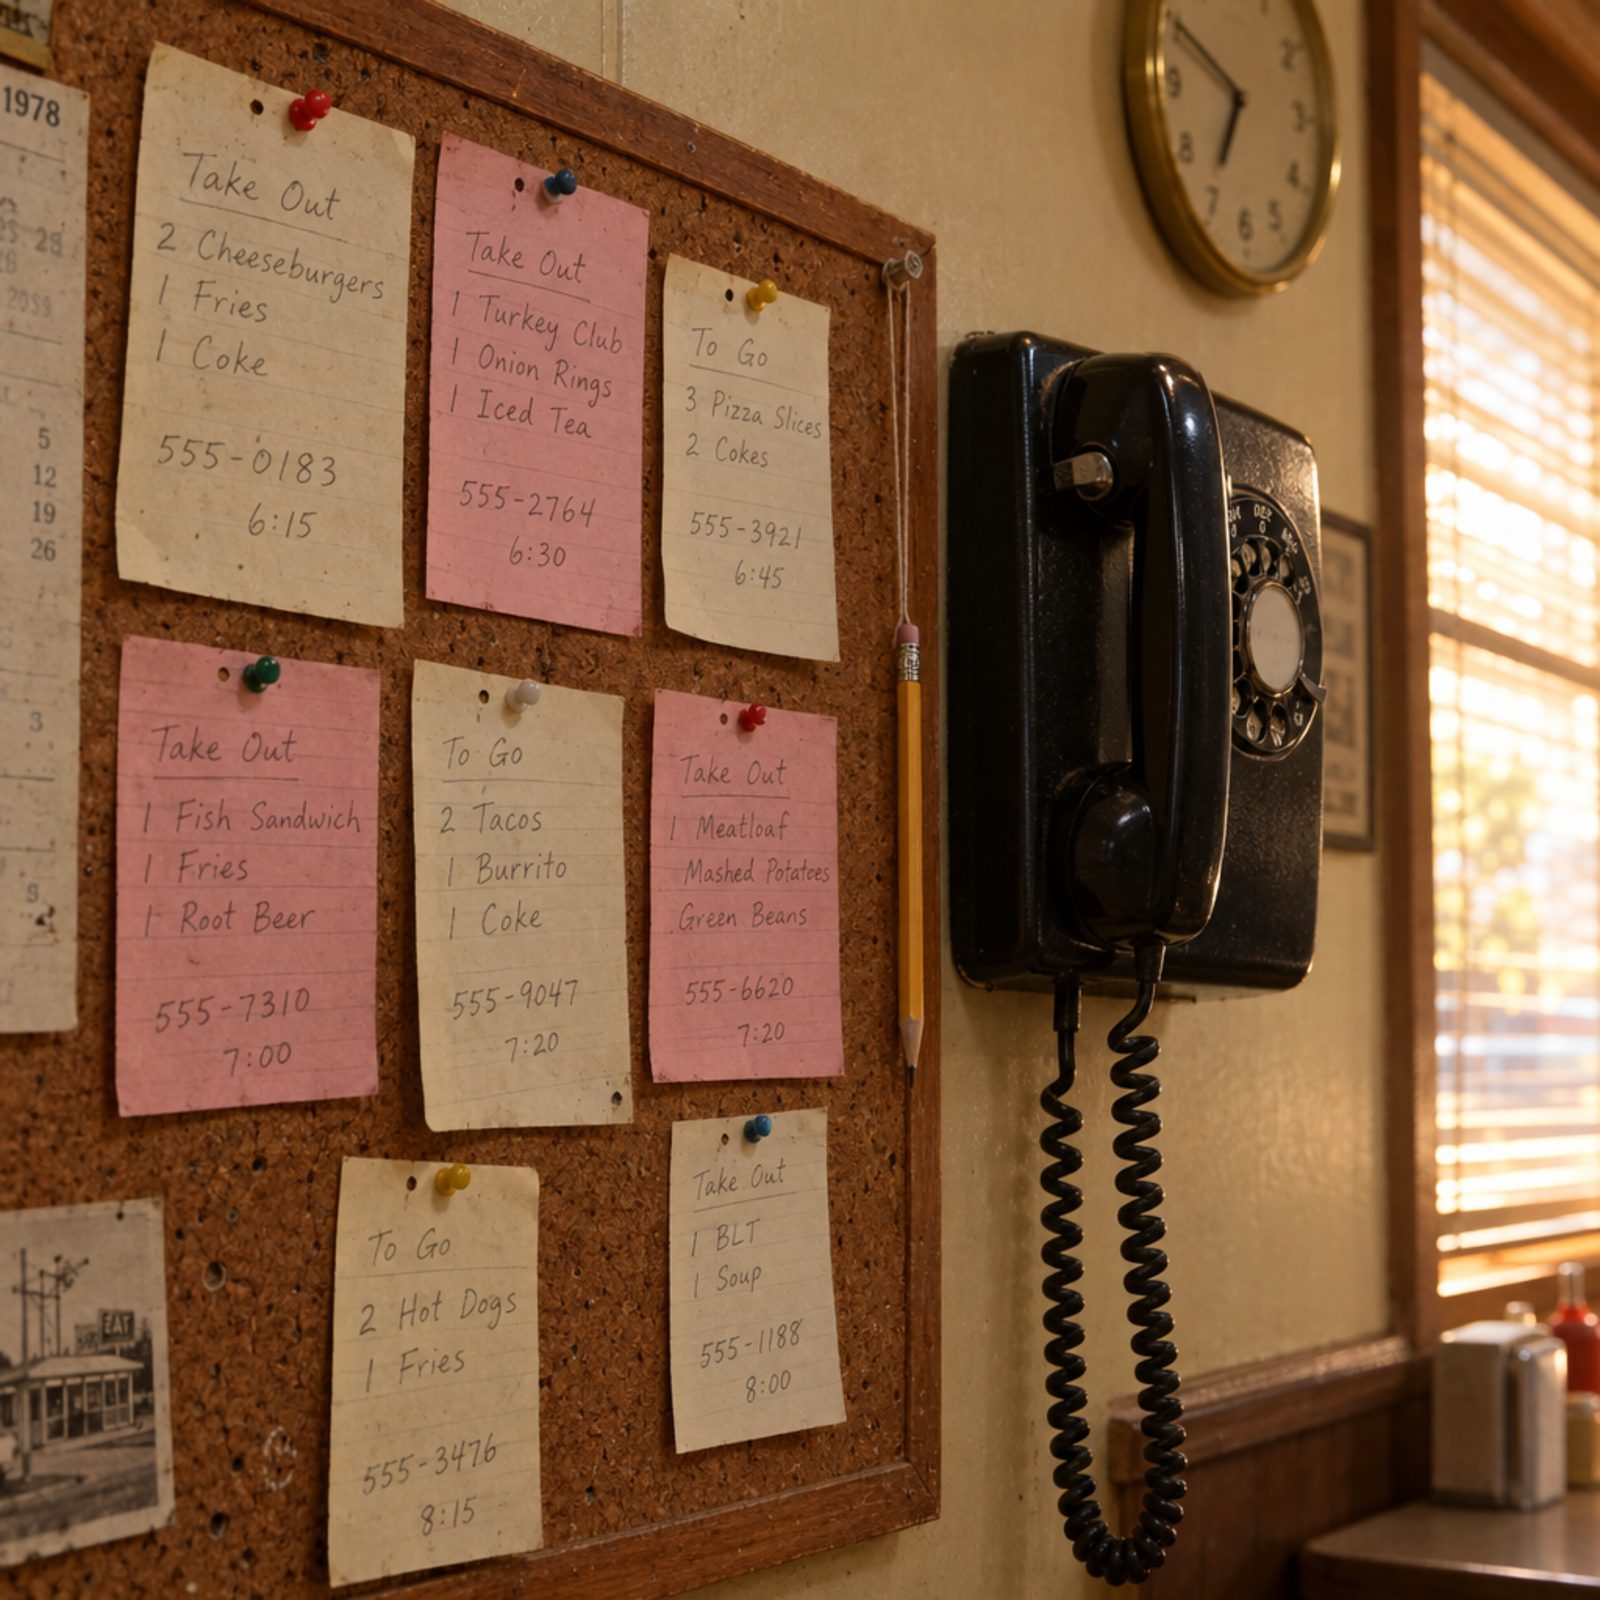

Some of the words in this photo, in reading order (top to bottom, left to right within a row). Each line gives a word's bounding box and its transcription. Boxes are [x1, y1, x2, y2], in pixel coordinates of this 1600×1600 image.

[3, 86, 60, 127] 1978
[183, 153, 258, 200] Take
[281, 180, 340, 220] Out
[157, 222, 176, 250] 2
[198, 229, 384, 303] Cheeseburgers
[466, 231, 524, 269] Take
[540, 250, 586, 283] Out
[159, 273, 169, 304] 1
[194, 280, 268, 322] Fries
[452, 290, 460, 316] 1
[479, 295, 558, 352] Turkey
[573, 320, 622, 354] Club
[157, 328, 166, 361] 1
[193, 335, 268, 376] Coke
[692, 327, 717, 356] To
[738, 338, 768, 367] Go
[452, 337, 459, 365] 1
[479, 343, 539, 380] Onion
[554, 359, 612, 408] Rings
[451, 384, 458, 412] 1
[477, 389, 533, 425] Iced
[550, 407, 591, 438] Tea
[685, 386, 697, 411] 3
[712, 390, 763, 425] Pizza
[774, 405, 822, 439] Slices
[38, 427, 50, 450] 5
[686, 433, 699, 456] 2
[715, 436, 768, 467] Cokes
[33, 464, 57, 488] 12
[158, 435, 336, 486] 555-0183
[32, 501, 56, 524] 19
[249, 502, 317, 538] 6:15
[460, 480, 596, 527] 555-2764
[690, 511, 802, 549] 555-3921
[31, 537, 56, 562] 26
[509, 536, 566, 567] 6:30
[735, 560, 784, 589] 6:45
[151, 724, 221, 762] Take
[241, 730, 297, 763] Out
[443, 736, 470, 769] To
[489, 737, 523, 767] Go
[680, 754, 731, 785] Take
[746, 758, 787, 785] Out
[143, 802, 151, 832] 1
[176, 798, 231, 832] Fish
[250, 800, 360, 832] Sandwich
[440, 806, 455, 833] 2
[473, 801, 542, 834] Tacos
[670, 815, 676, 841] 1
[696, 811, 790, 841] Meatloaf
[144, 854, 152, 884] 1
[178, 849, 248, 883] Fries
[448, 857, 454, 887] 1
[476, 851, 567, 885] Burrito
[684, 857, 754, 885] Mashed
[145, 905, 152, 938] 1
[180, 900, 236, 934] Root
[253, 900, 316, 933] Beer
[450, 907, 455, 939] 1
[482, 900, 543, 936] Coke
[678, 902, 737, 931] Green
[752, 901, 807, 928] Beans
[452, 979, 578, 1020] 555-9047
[686, 975, 794, 1006] 555-6620
[155, 988, 310, 1033] 555-7310
[505, 1032, 558, 1063] 7:20
[737, 1022, 785, 1047] 7:20
[223, 1041, 292, 1077] 7:00
[692, 1167, 737, 1200] Take
[751, 1158, 786, 1188] Out
[369, 1229, 397, 1265] To
[416, 1227, 451, 1260] Go
[692, 1232, 697, 1256] 1
[716, 1218, 760, 1251] BLT
[694, 1273, 699, 1298] 1
[716, 1264, 761, 1292] Soup
[102, 1311, 132, 1336] EAT
[360, 1304, 376, 1336] 2
[399, 1291, 442, 1330] Hot
[461, 1288, 517, 1330] Dogs
[700, 1319, 803, 1368] 555-1188
[366, 1358, 373, 1393] 1
[400, 1347, 465, 1385] Fries
[746, 1369, 791, 1403] 8:00
[363, 1433, 497, 1495] 555-3476
[422, 1496, 477, 1536] 8:15
